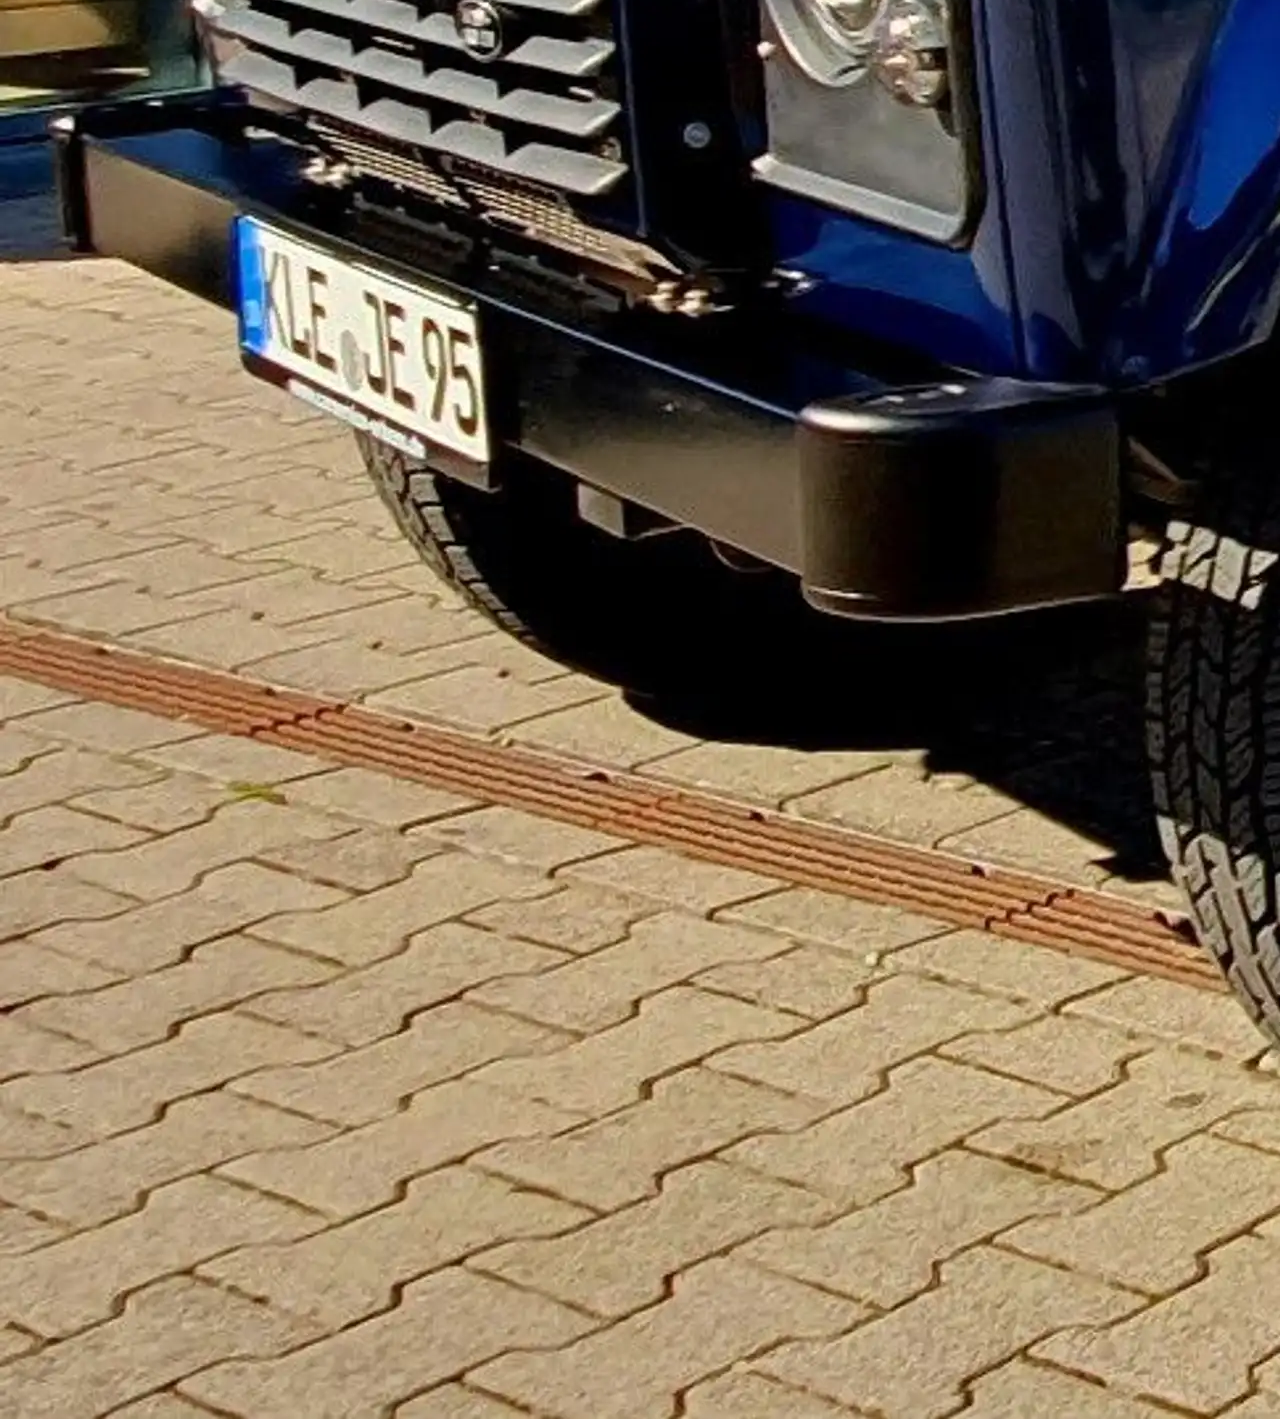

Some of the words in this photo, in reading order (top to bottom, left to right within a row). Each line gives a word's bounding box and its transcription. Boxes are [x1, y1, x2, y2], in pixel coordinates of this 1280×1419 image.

[260, 246, 338, 373] KLE
[362, 290, 416, 411] JE
[421, 316, 479, 436] 95
